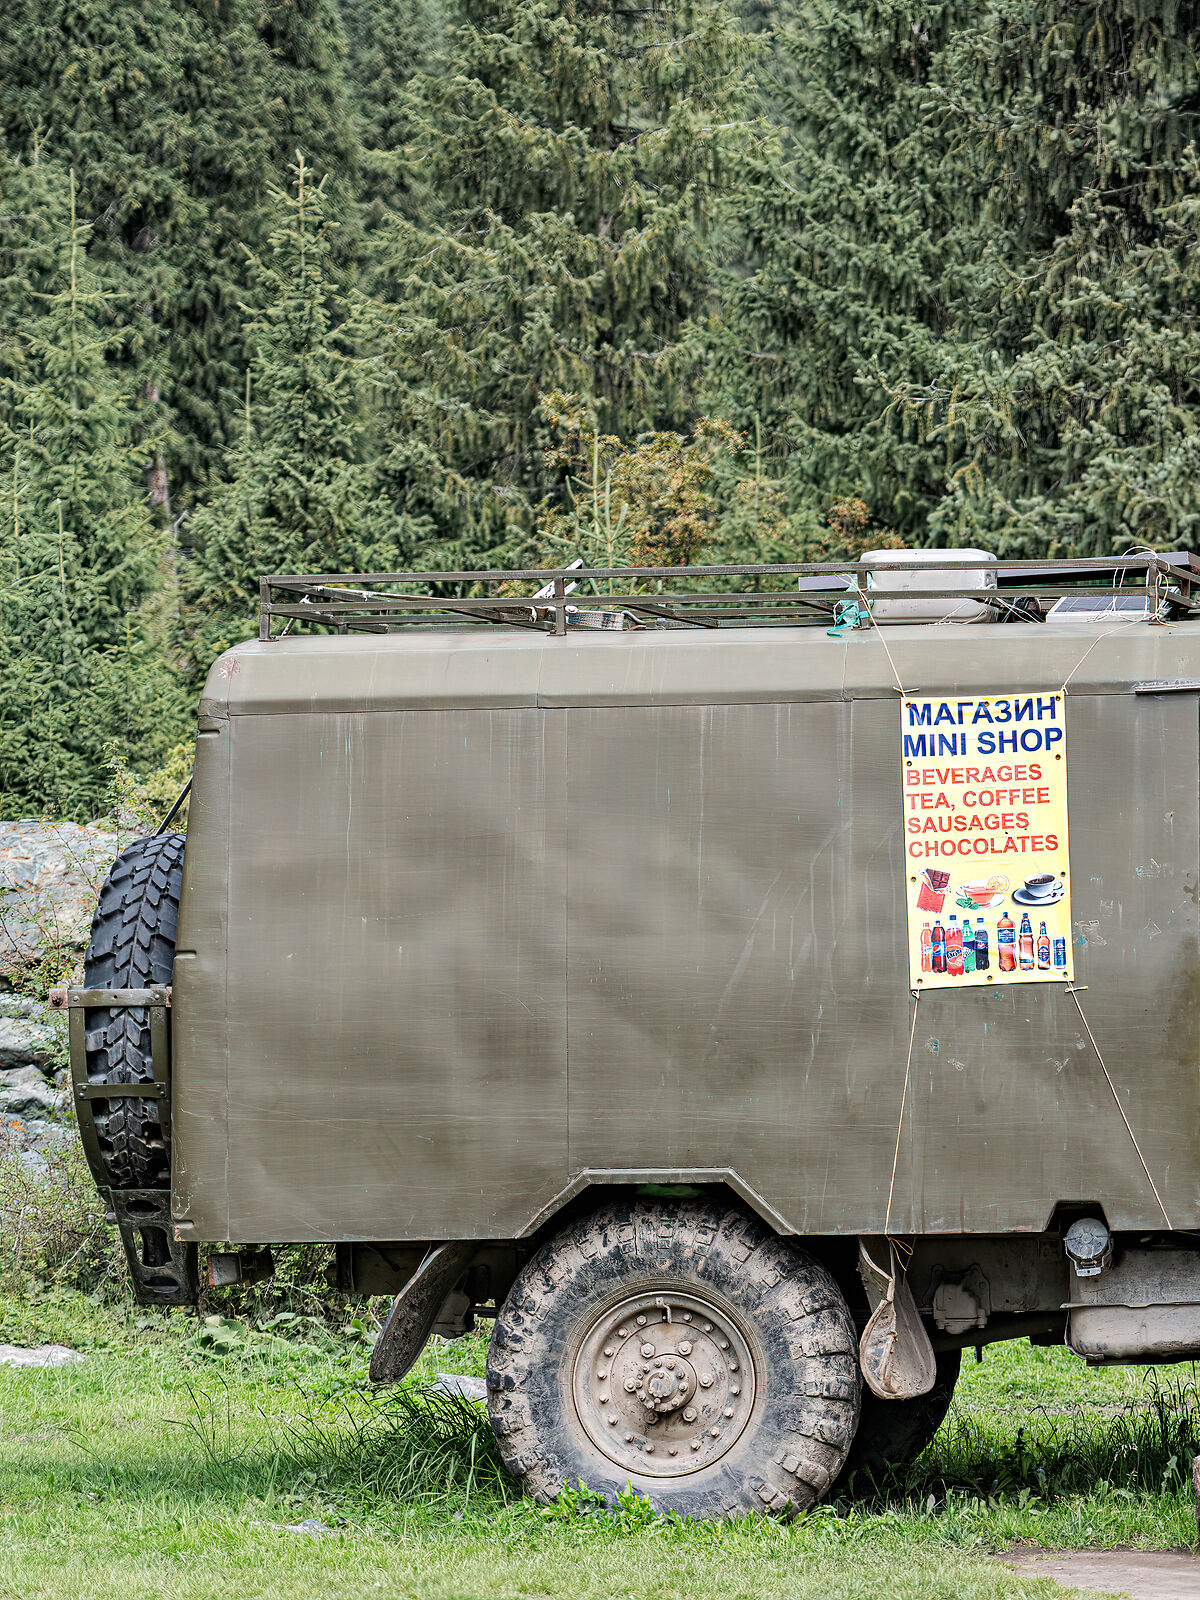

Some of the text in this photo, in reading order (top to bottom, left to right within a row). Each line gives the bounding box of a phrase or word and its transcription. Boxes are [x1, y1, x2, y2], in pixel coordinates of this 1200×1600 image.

[908, 697, 1056, 726] МАГАЗИН
[903, 727, 1063, 757] MINI SHOP
[906, 763, 1042, 786] BEVERAGES
[906, 787, 1050, 811] TEA, COFFEE
[907, 812, 1030, 834] SAUSAGES
[908, 835, 1059, 858] CHOCOLATES
